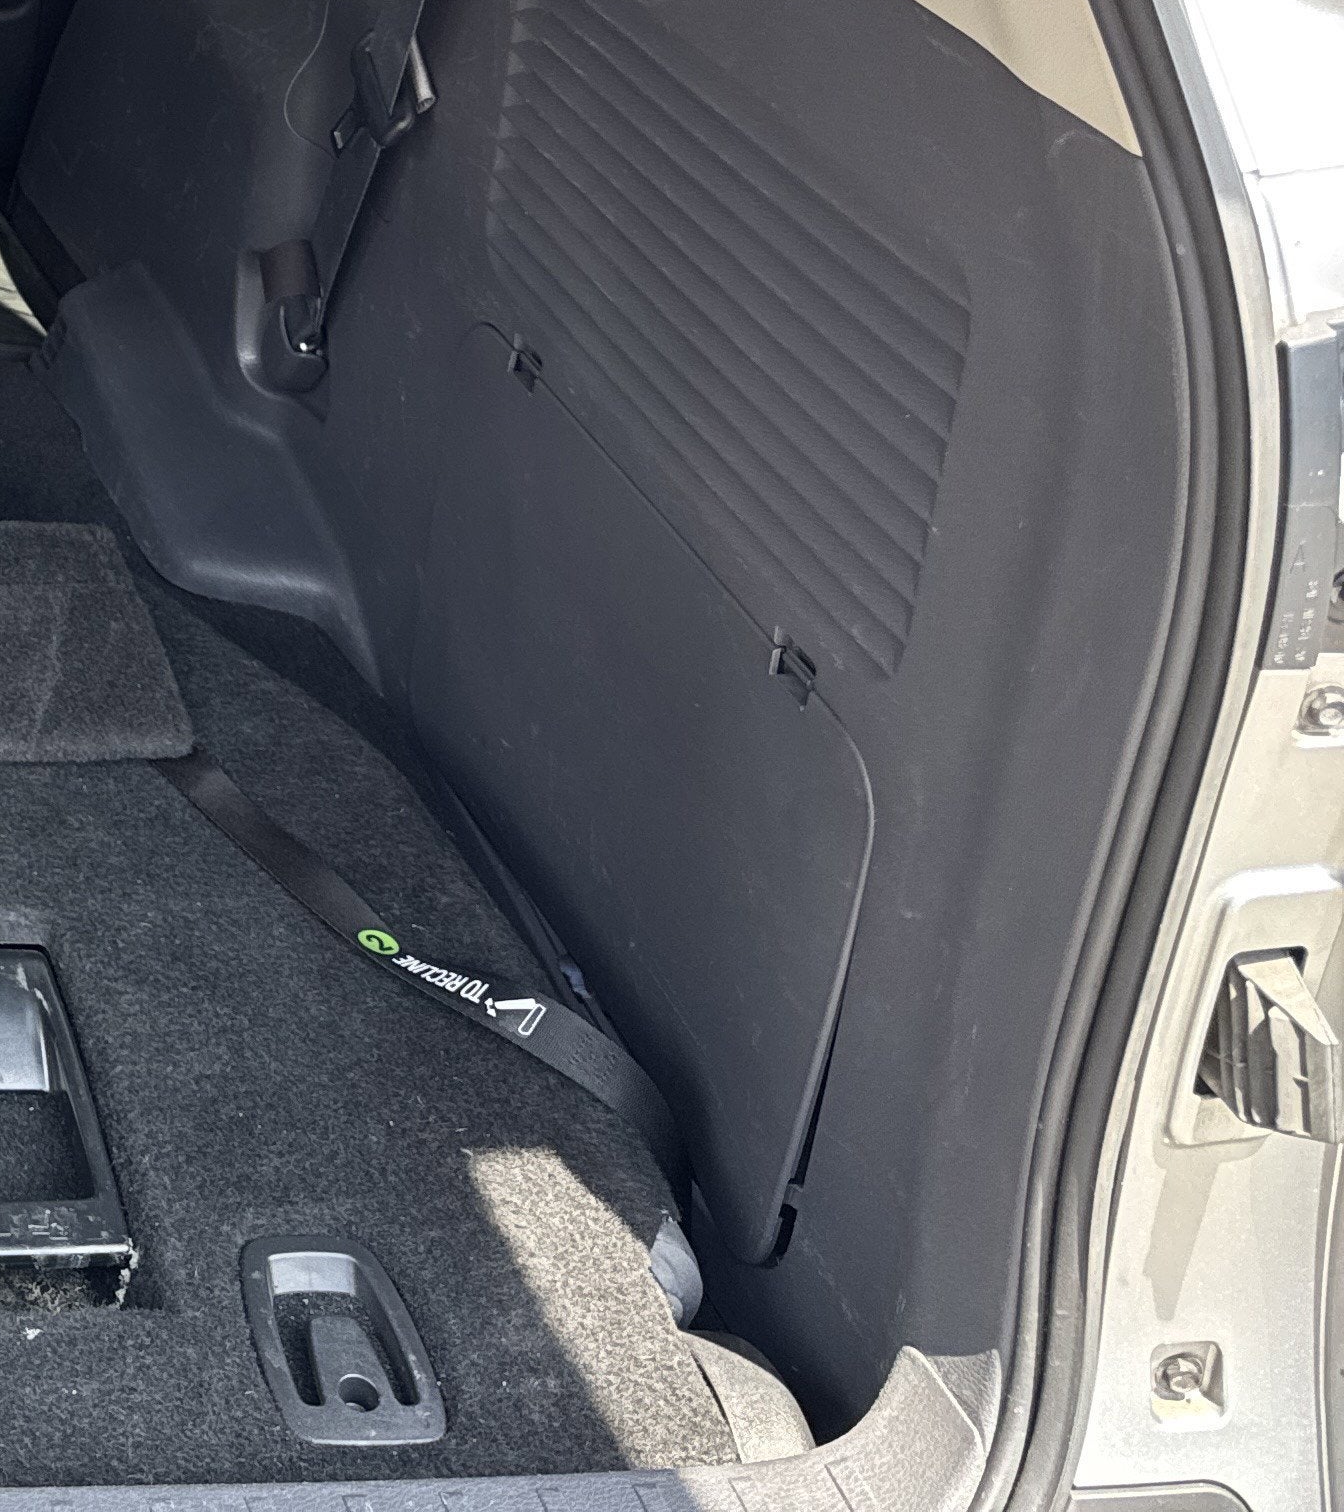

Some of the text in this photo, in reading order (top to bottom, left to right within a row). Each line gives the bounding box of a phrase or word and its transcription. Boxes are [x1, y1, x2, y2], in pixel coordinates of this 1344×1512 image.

[365, 933, 394, 951] 2
[391, 954, 490, 1004] TO RECLINE
